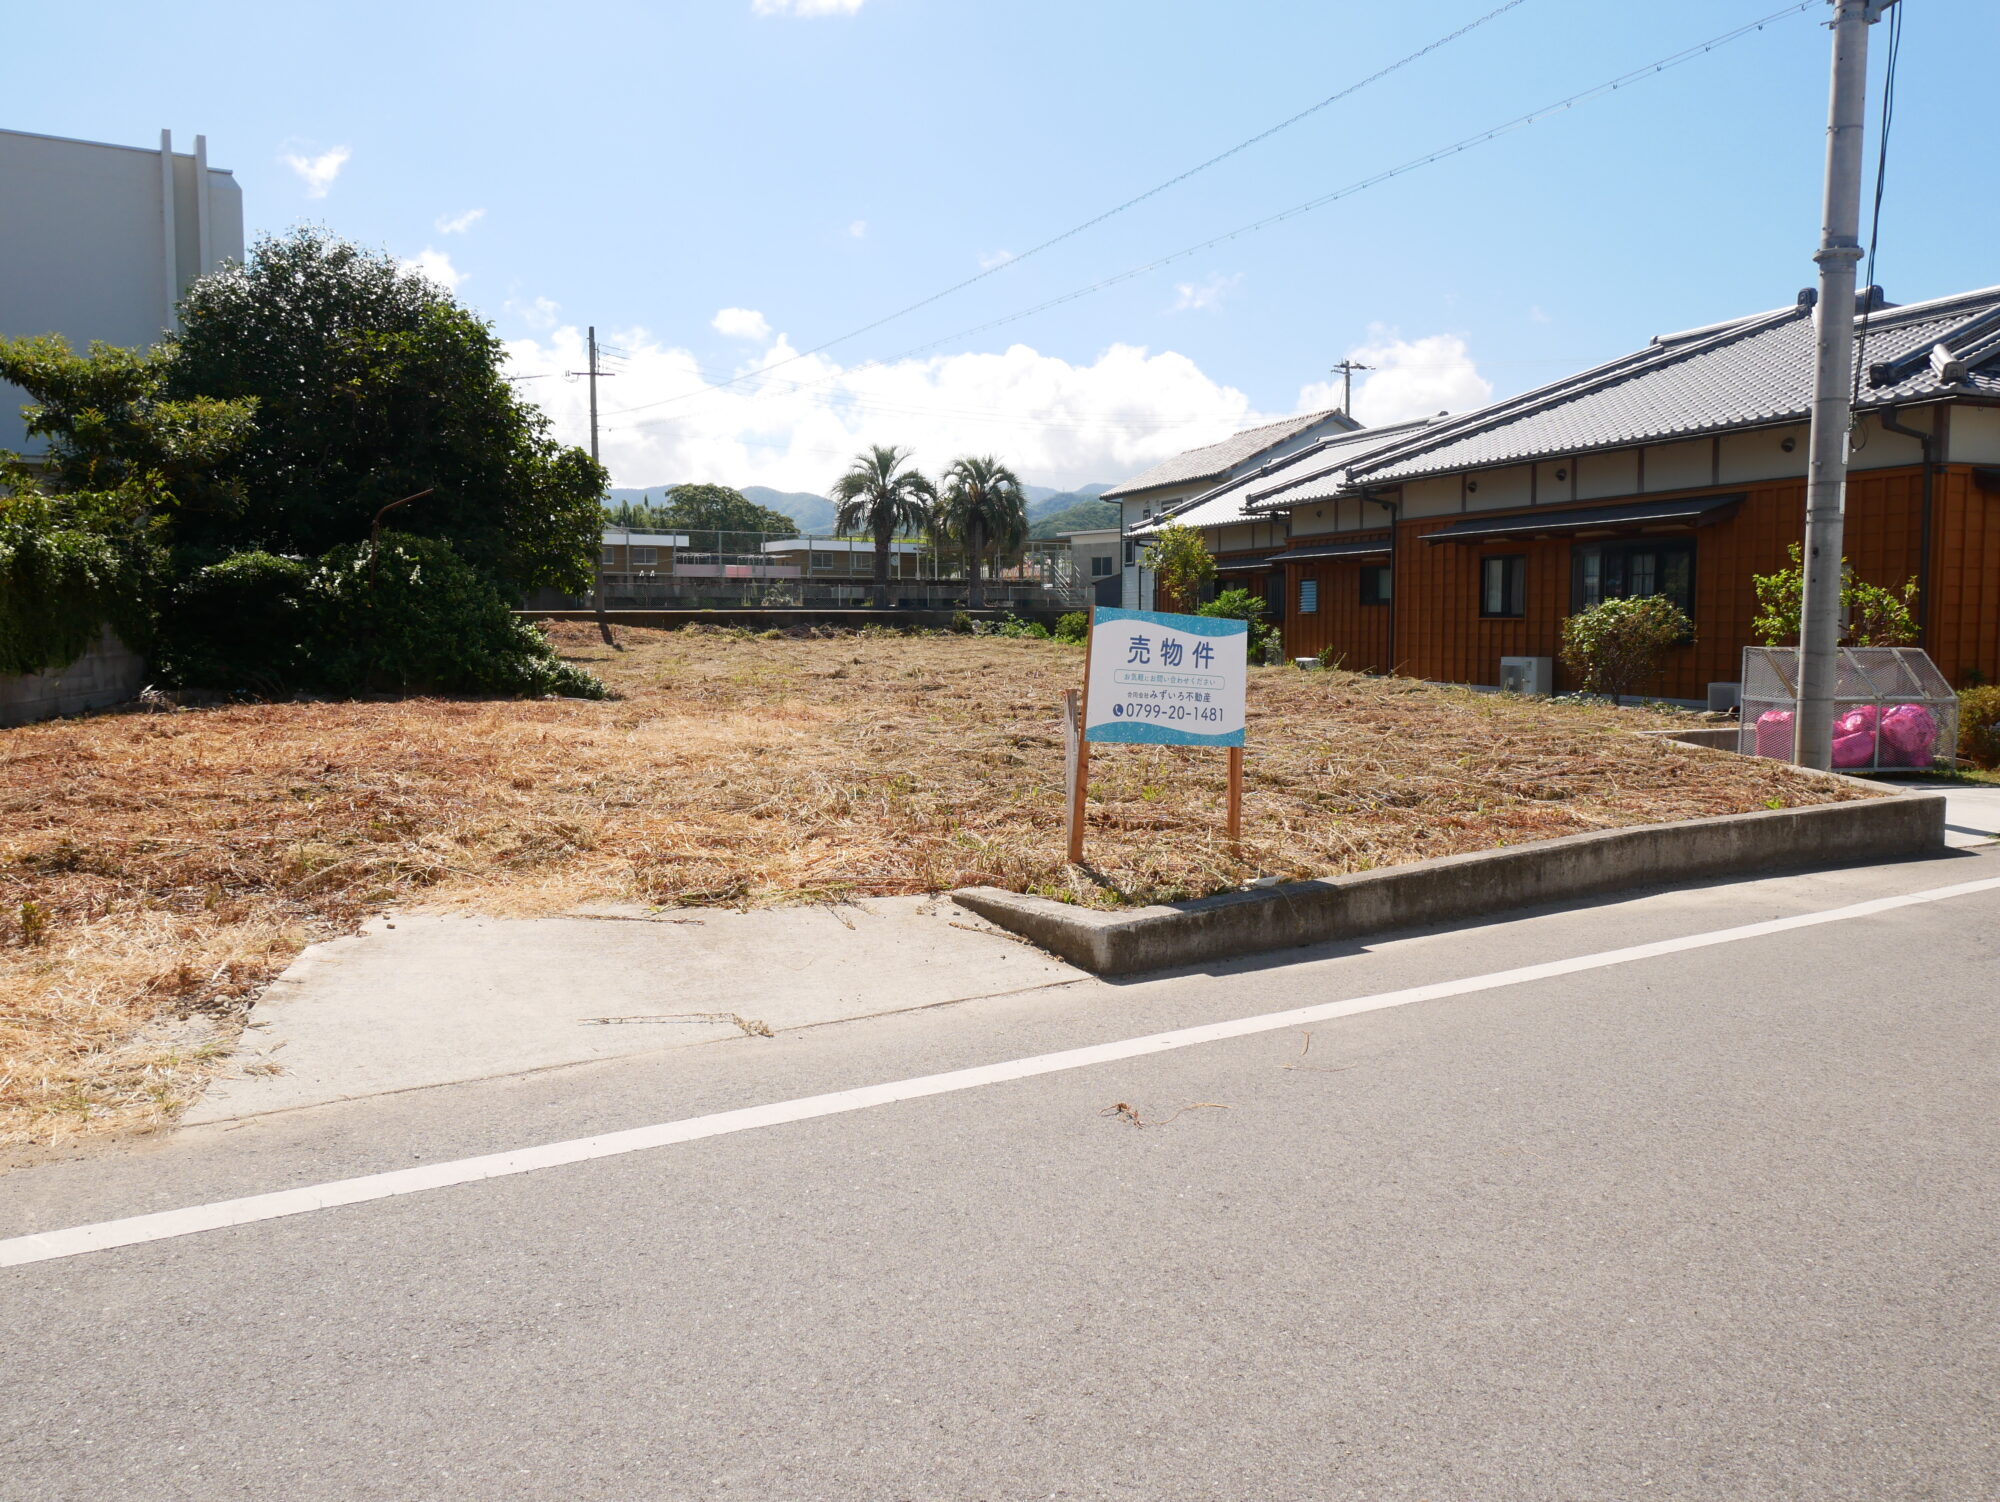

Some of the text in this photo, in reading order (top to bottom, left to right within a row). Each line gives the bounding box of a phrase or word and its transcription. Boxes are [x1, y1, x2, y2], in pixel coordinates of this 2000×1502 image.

[1127, 634, 1215, 670] 売物件
[1124, 673, 1216, 687] お気軽にお問い合わせください
[1126, 703, 1224, 722] 0799-20-1481
